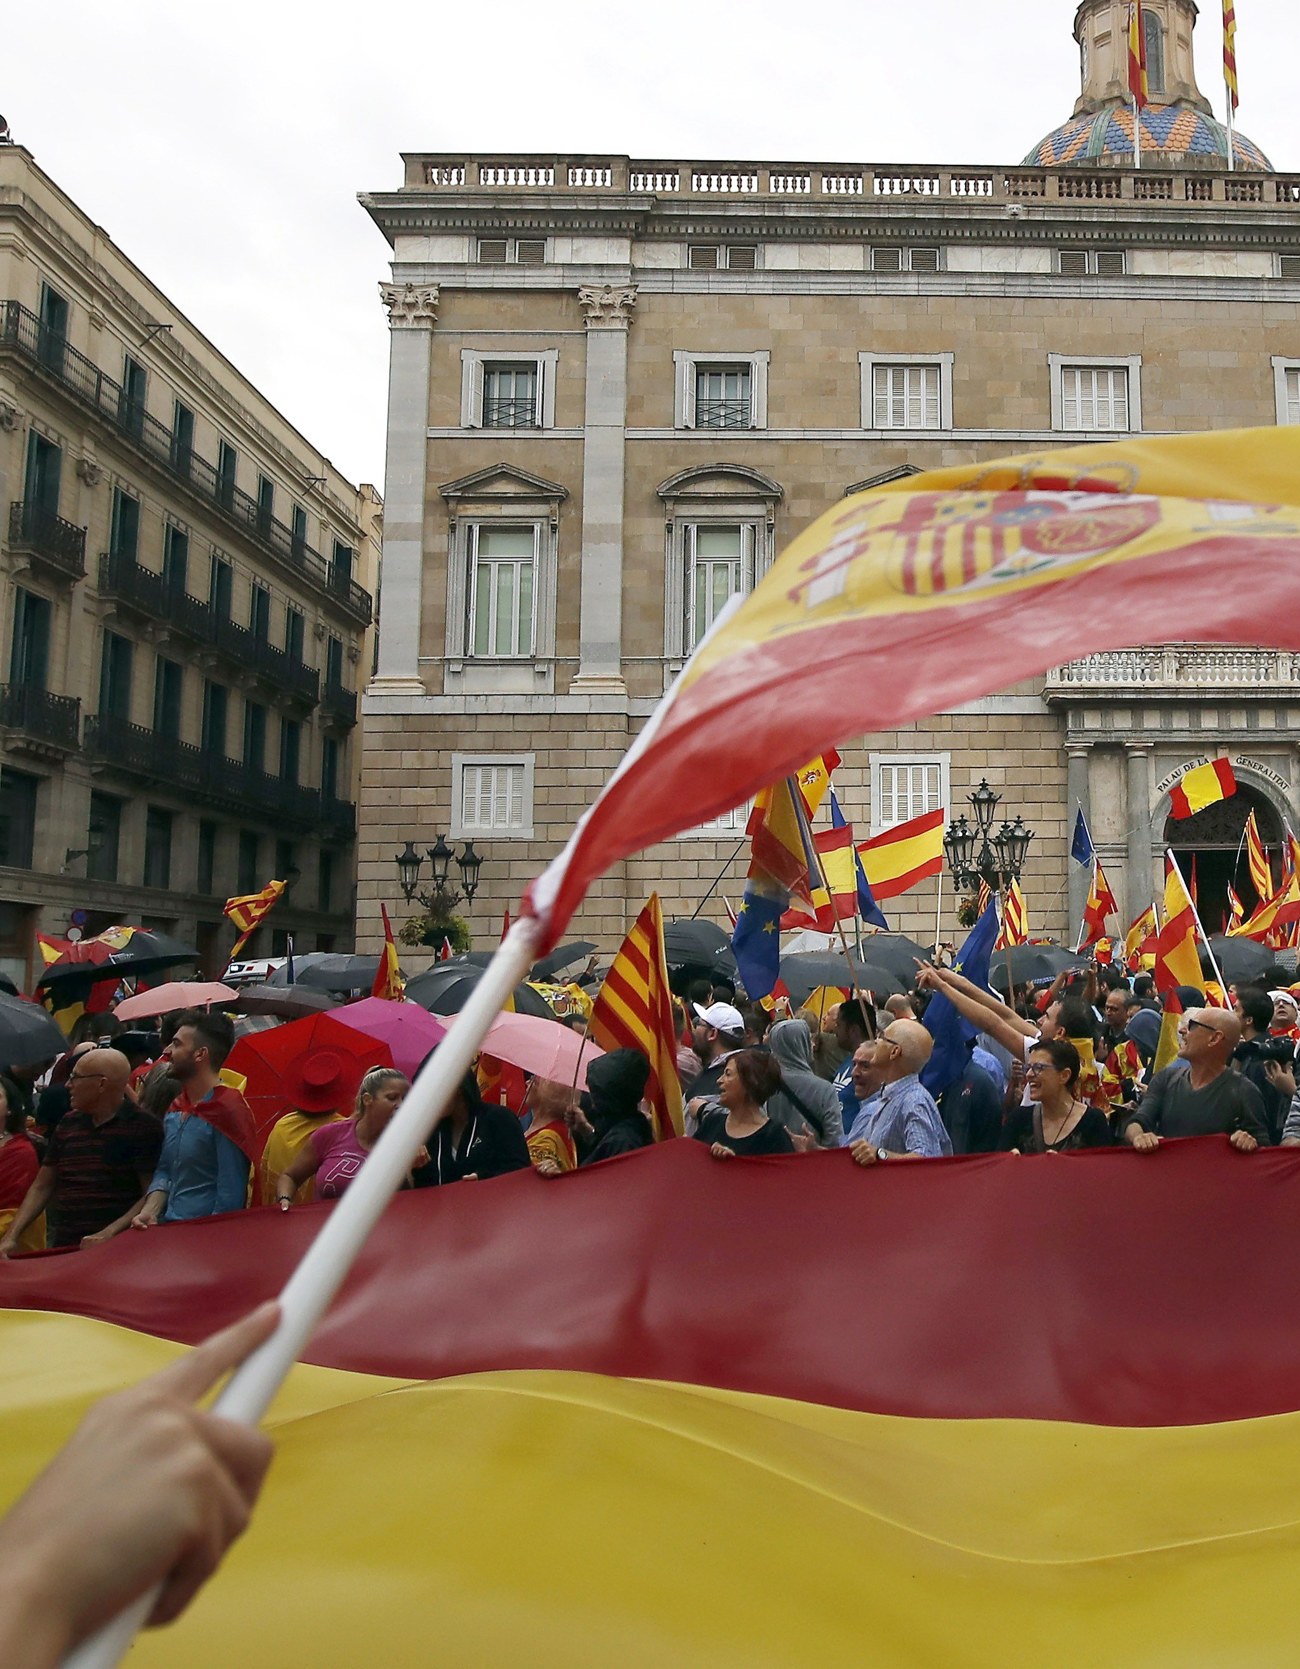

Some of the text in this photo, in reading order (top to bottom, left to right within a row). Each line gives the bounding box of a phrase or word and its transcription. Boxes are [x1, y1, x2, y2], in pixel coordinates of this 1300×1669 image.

[1157, 757, 1290, 792] PALAU DE LA GENERALITAT
